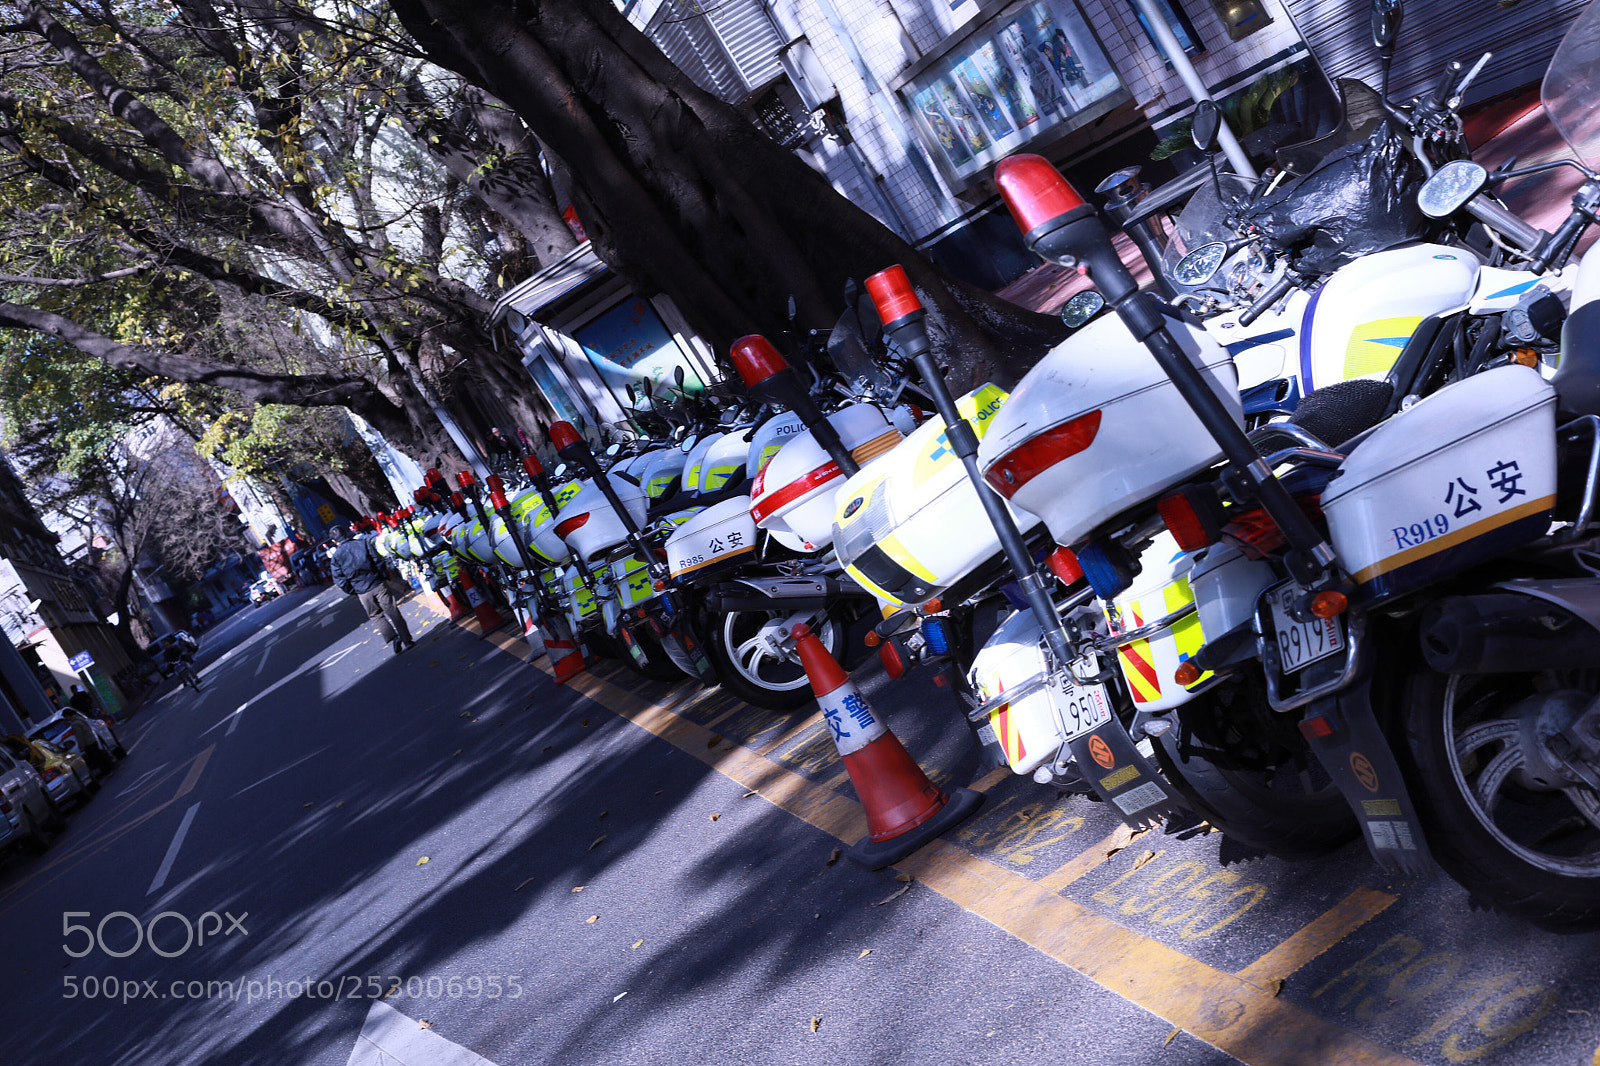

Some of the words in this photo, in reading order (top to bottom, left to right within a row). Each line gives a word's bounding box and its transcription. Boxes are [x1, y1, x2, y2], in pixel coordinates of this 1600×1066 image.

[970, 396, 1005, 425] POLICE
[776, 423, 808, 436] POLIC
[1444, 459, 1527, 520] 公安
[708, 531, 744, 554] 公安
[1391, 512, 1450, 550] R919
[679, 554, 704, 569] R985
[823, 691, 876, 743] 交警
